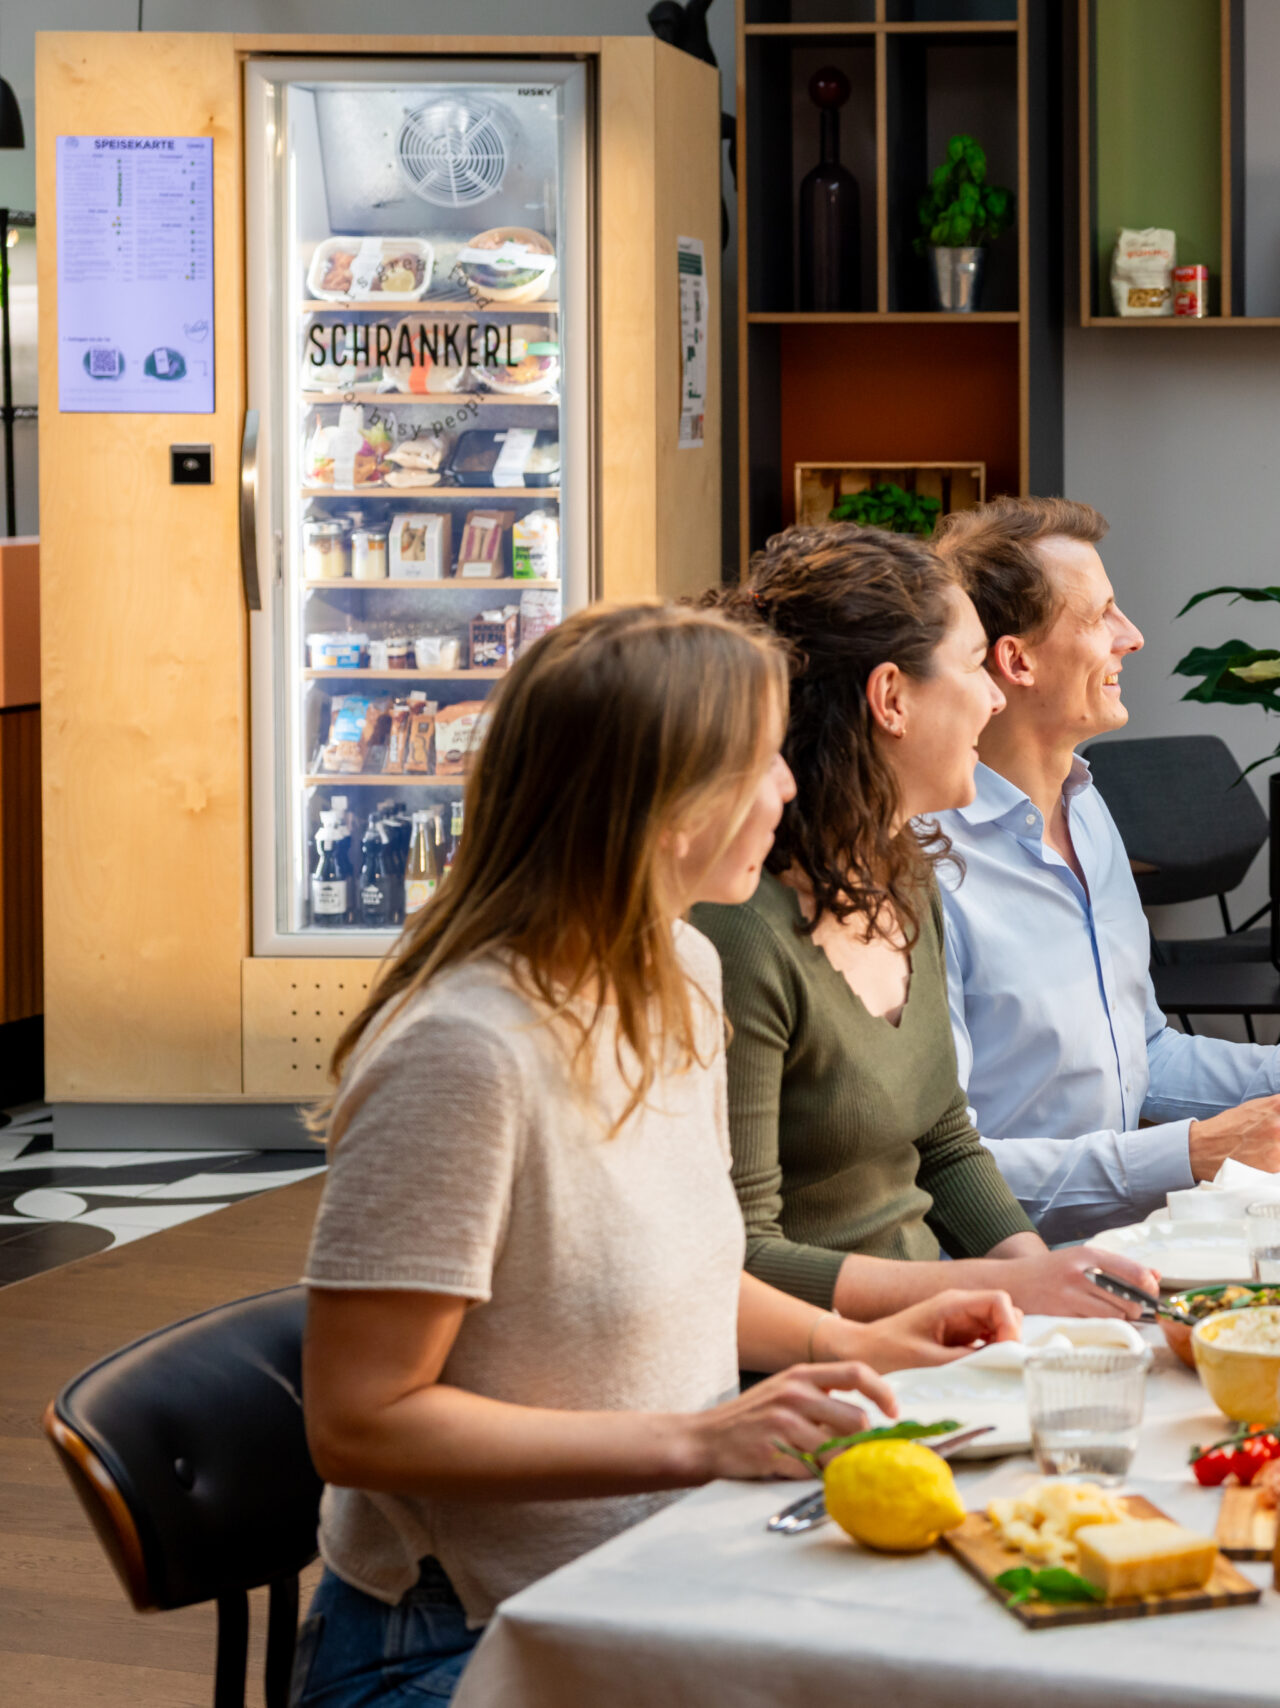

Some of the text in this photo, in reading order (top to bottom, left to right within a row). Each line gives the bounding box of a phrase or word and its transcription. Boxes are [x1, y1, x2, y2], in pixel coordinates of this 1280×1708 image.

[94, 139, 175, 150] SPEISEKARTE
[376, 258, 439, 283] great
[447, 260, 494, 310] food
[309, 323, 519, 367] SCHRANKERL
[368, 407, 422, 441] busy
[431, 385, 487, 438] peopl
